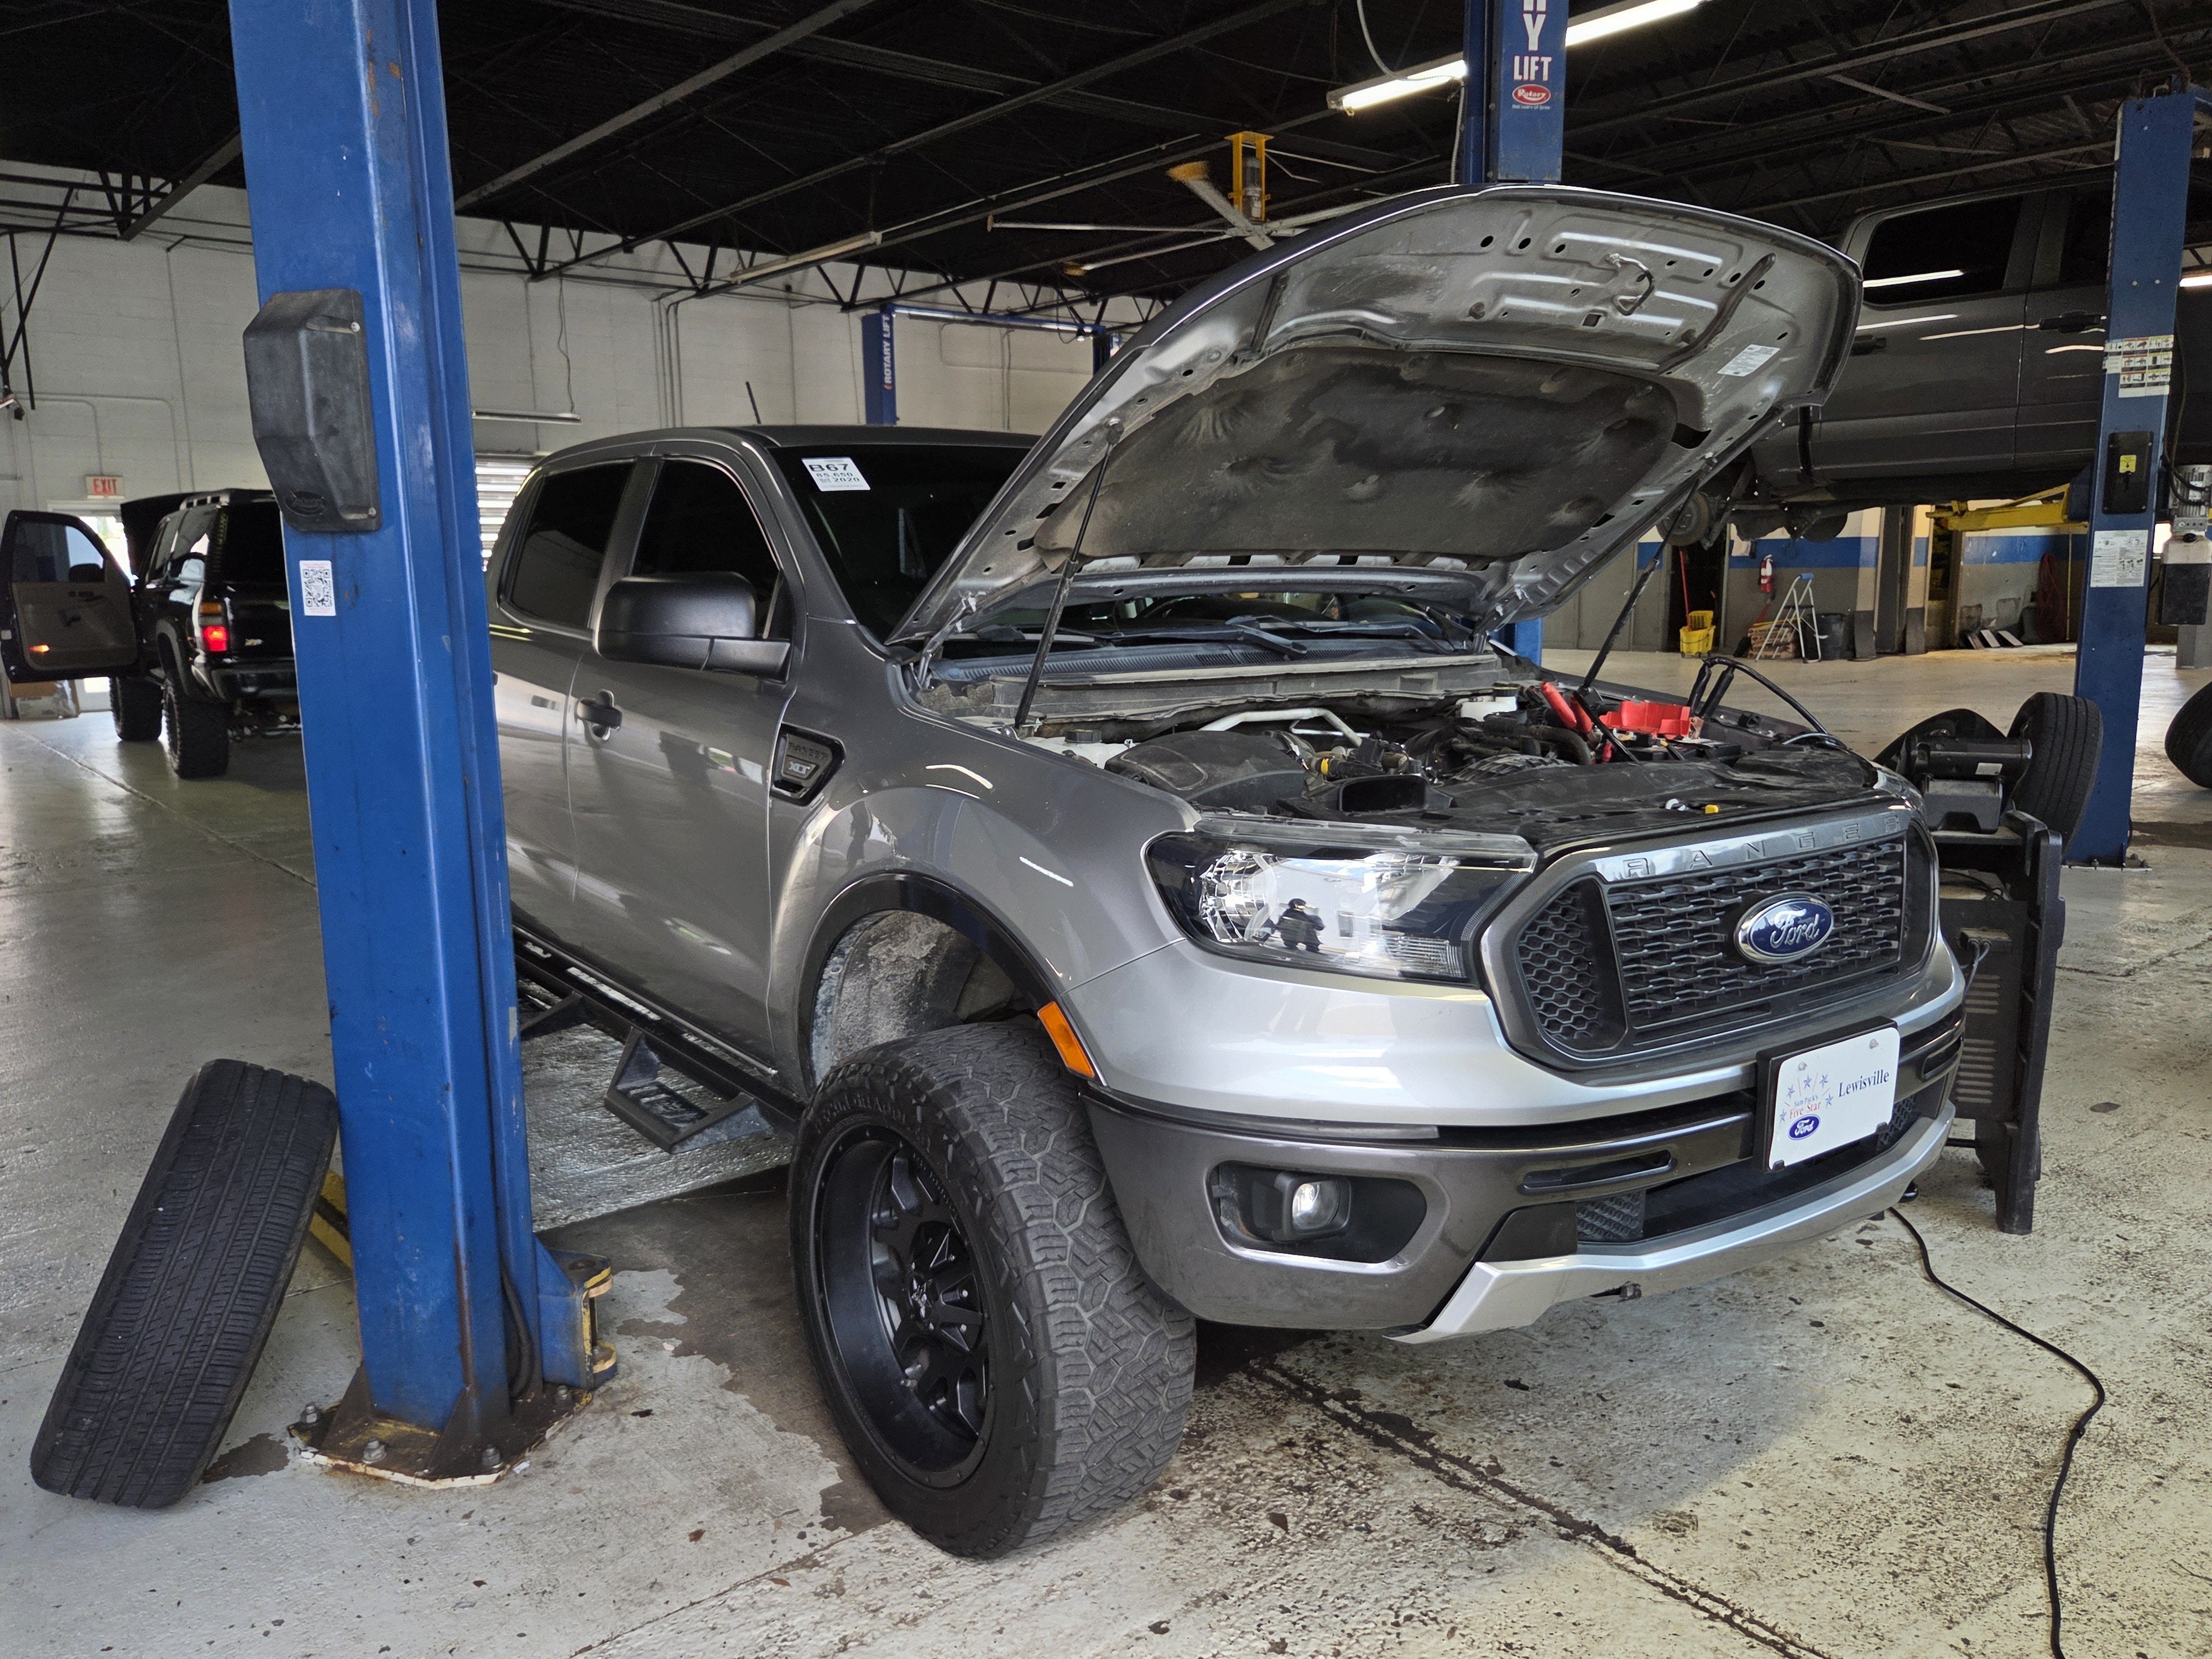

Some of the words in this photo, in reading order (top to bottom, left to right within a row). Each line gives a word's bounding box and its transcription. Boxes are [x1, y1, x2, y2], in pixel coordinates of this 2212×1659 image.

[1513, 55, 1552, 81] LIFT
[883, 315, 891, 338] LIFT
[883, 341, 892, 384] ROTARY
[808, 463, 848, 472] B67
[93, 478, 117, 495] EXIT
[1623, 814, 1901, 879] RANGER
[1770, 907, 1820, 950] Ford
[1838, 1069, 1890, 1098] Lewisville
[1790, 1108, 1804, 1119] Five
[1806, 1101, 1822, 1113] Star
[1794, 1118, 1814, 1136] Ford
